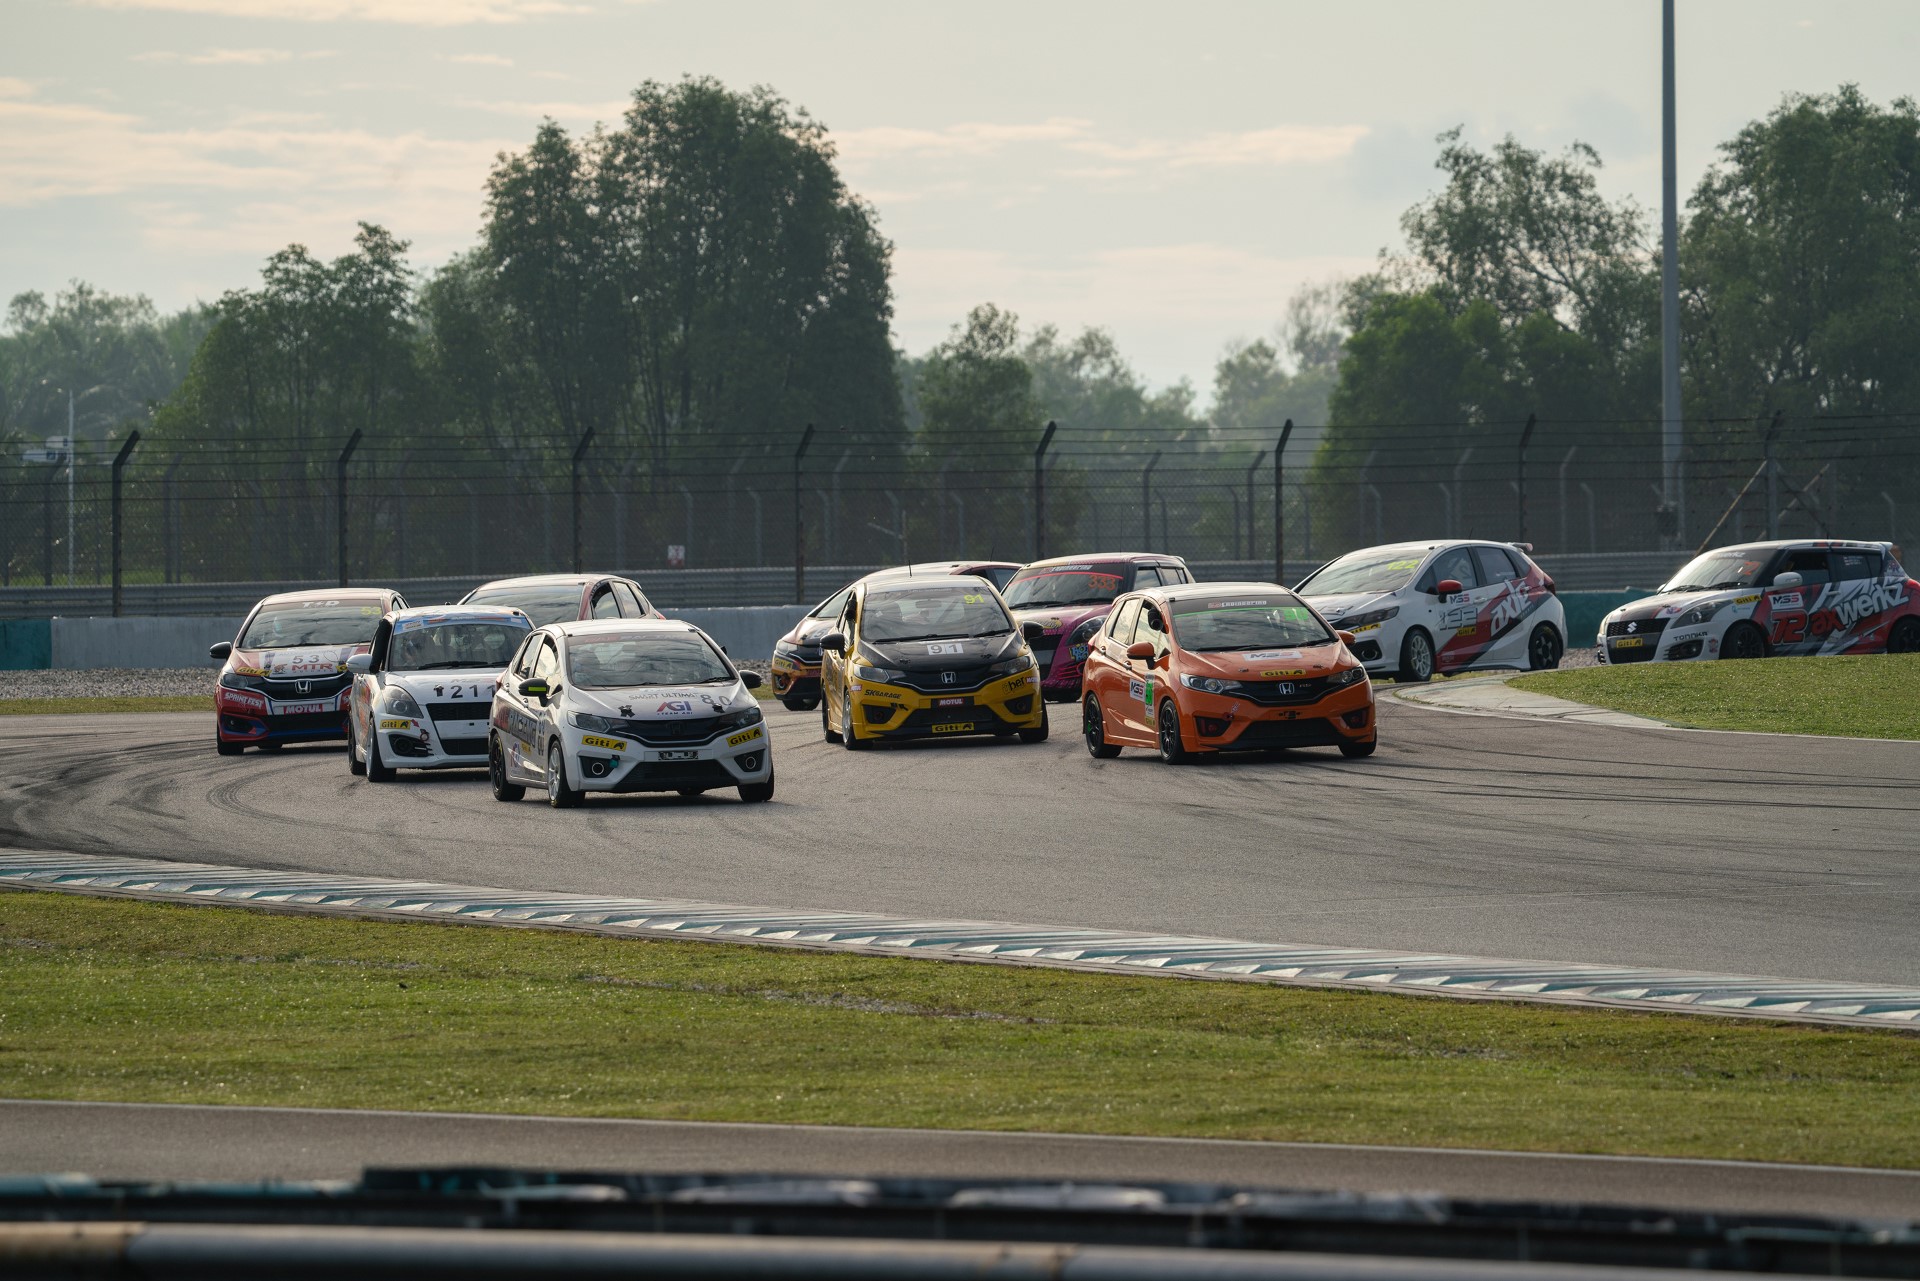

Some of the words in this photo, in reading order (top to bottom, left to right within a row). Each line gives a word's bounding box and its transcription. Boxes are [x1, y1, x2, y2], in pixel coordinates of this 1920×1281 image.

[1387, 560, 1418, 571] 122
[1088, 575, 1115, 591] 333
[964, 594, 984, 605] 91
[361, 607, 381, 615] 53
[1617, 637, 1632, 648] Giti
[930, 645, 958, 654] 91
[292, 655, 320, 664] 53
[450, 684, 496, 699] 211
[700, 694, 732, 706] 80
[939, 698, 963, 706] MOTUL
[286, 704, 322, 713] MOTUL
[656, 701, 692, 712] AGI
[381, 721, 397, 729] Giti
[934, 724, 958, 732] Giti
[585, 737, 610, 747] Giti
[730, 735, 751, 746] Giti
